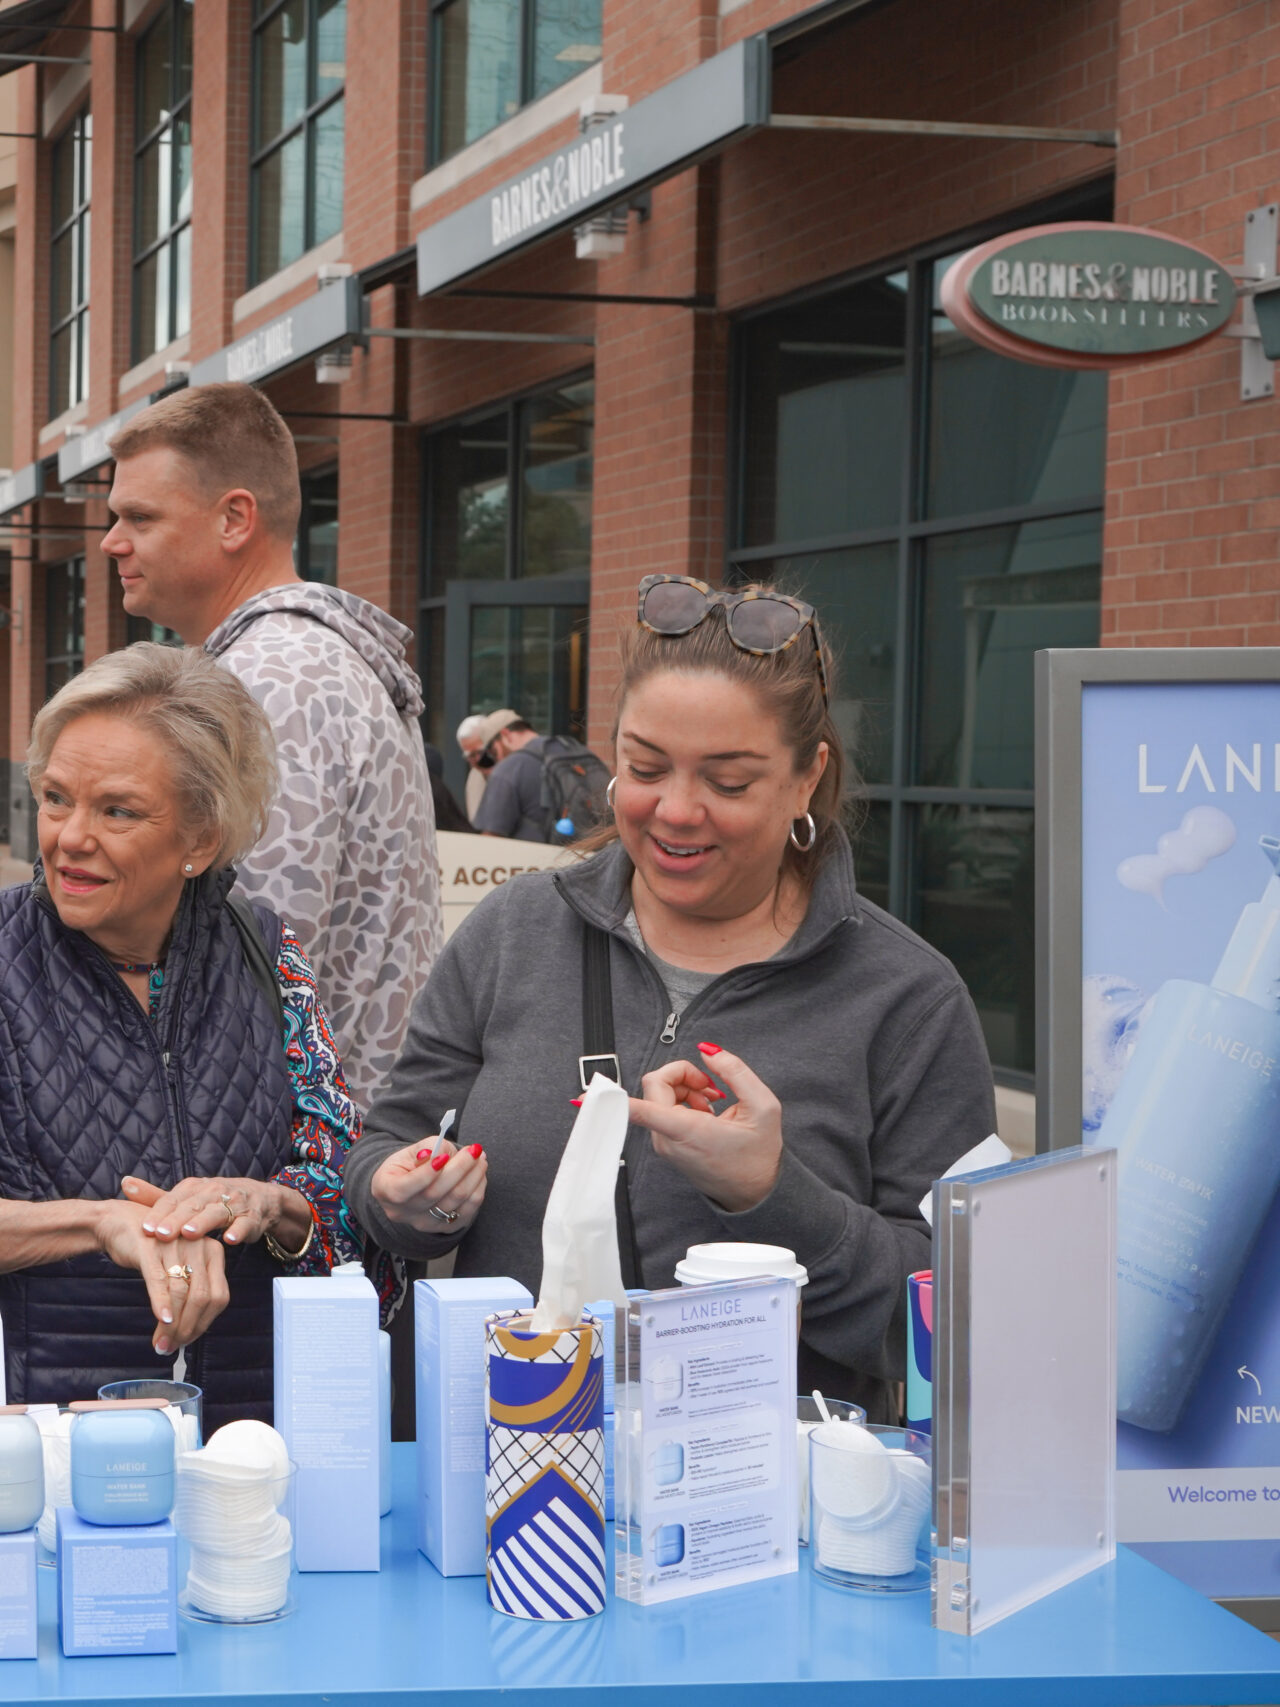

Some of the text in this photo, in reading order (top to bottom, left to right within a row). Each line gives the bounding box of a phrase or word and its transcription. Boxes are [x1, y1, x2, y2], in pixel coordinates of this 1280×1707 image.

[1138, 743, 1280, 793] LAN
[453, 866, 558, 885] ACC
[1188, 1023, 1277, 1078] LANEIGE
[681, 1298, 742, 1321] LANEIGE
[656, 1323, 710, 1338] BARRIER-BOOSTING
[711, 1318, 743, 1330] HYDRATION
[744, 1316, 756, 1324] FOR
[1236, 1406, 1280, 1424] NEW
[1167, 1485, 1280, 1503] Welcome to
